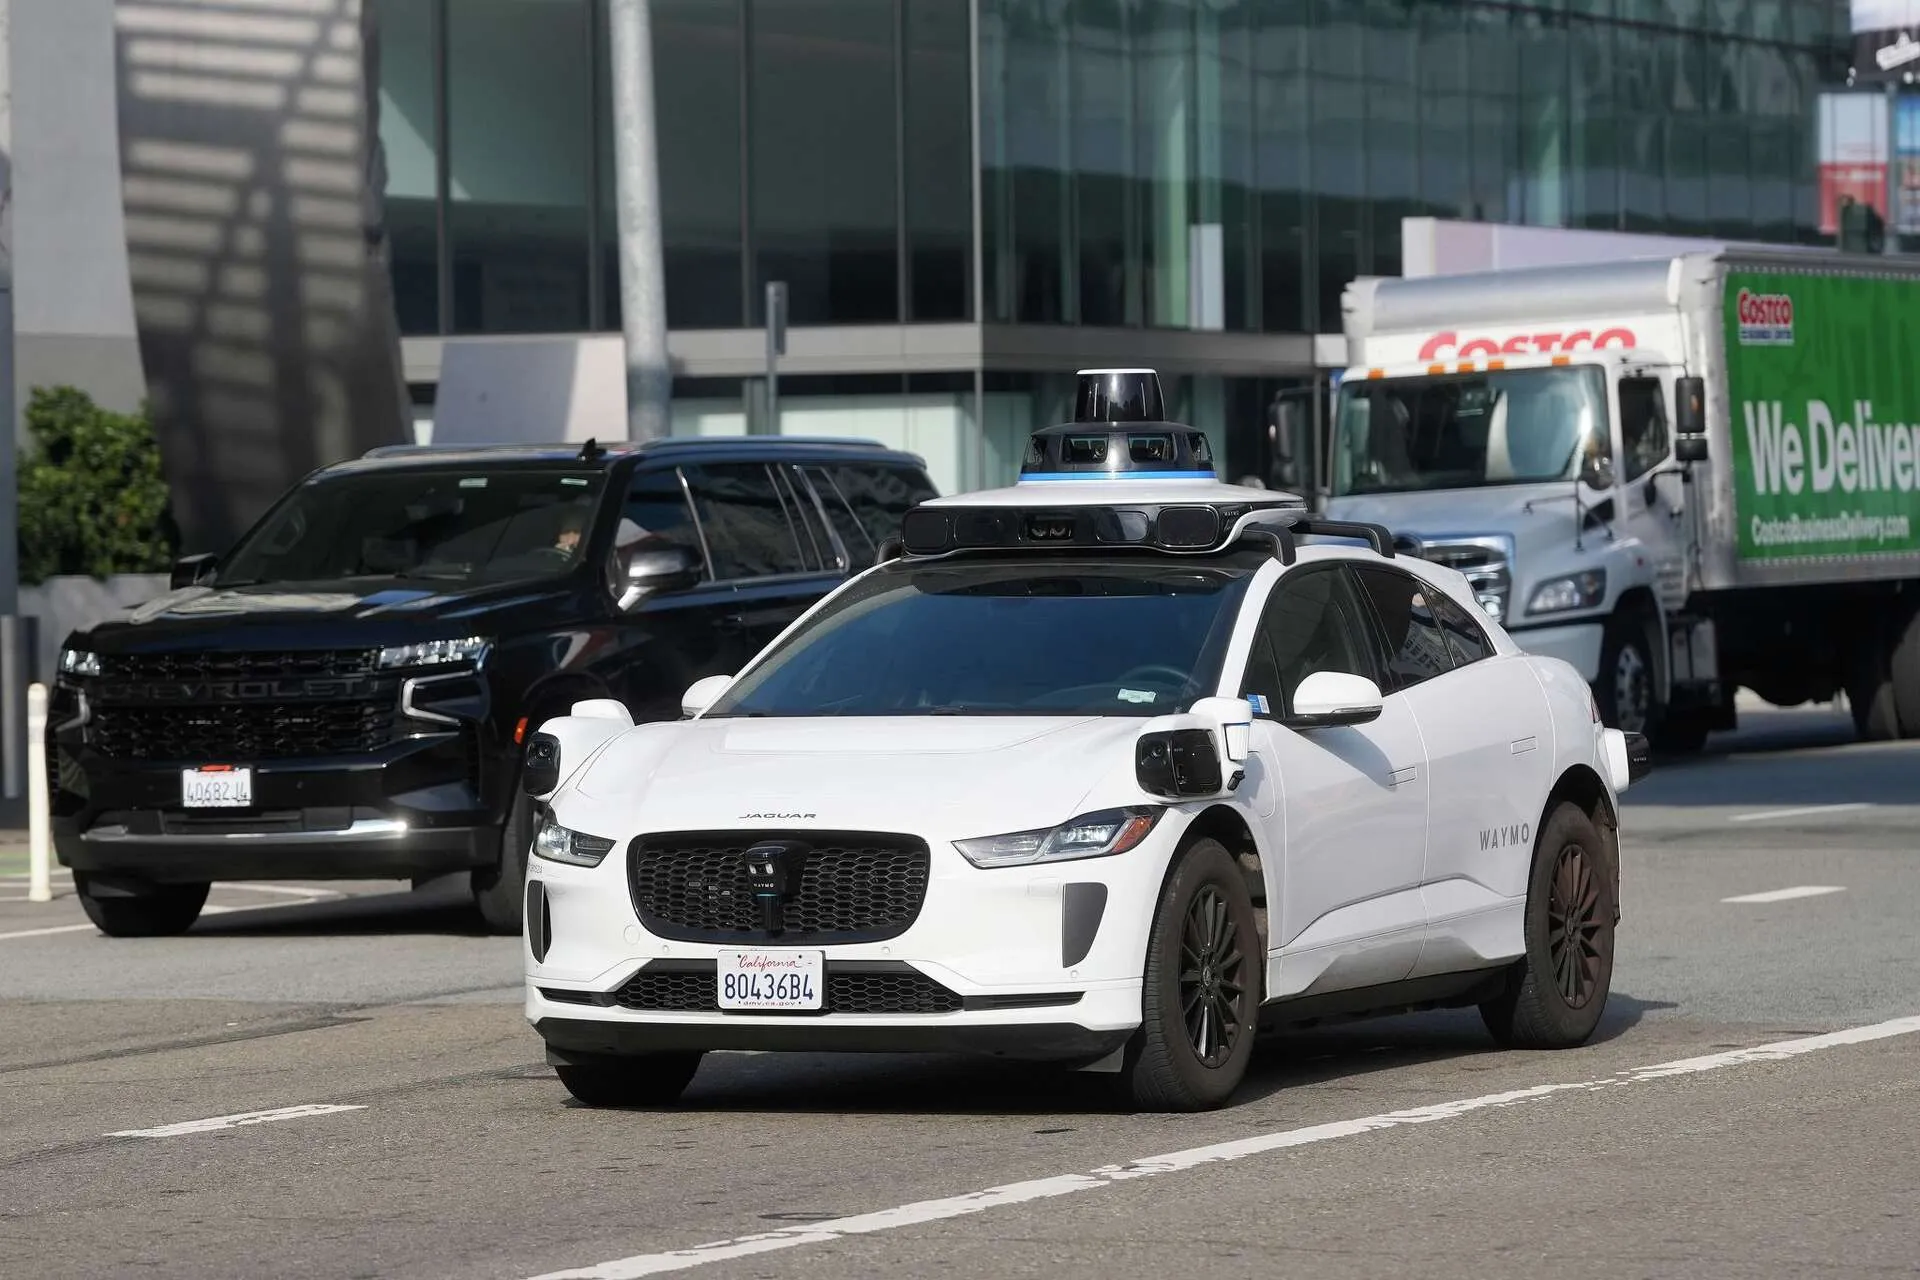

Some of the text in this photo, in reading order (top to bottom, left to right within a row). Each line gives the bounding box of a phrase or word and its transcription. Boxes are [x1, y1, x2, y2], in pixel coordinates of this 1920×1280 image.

[1738, 290, 1793, 325] COSTCO
[1744, 400, 1804, 495] We
[1480, 822, 1530, 851] WAYMO
[739, 954, 803, 972] California
[724, 973, 814, 1000] 80436B4
